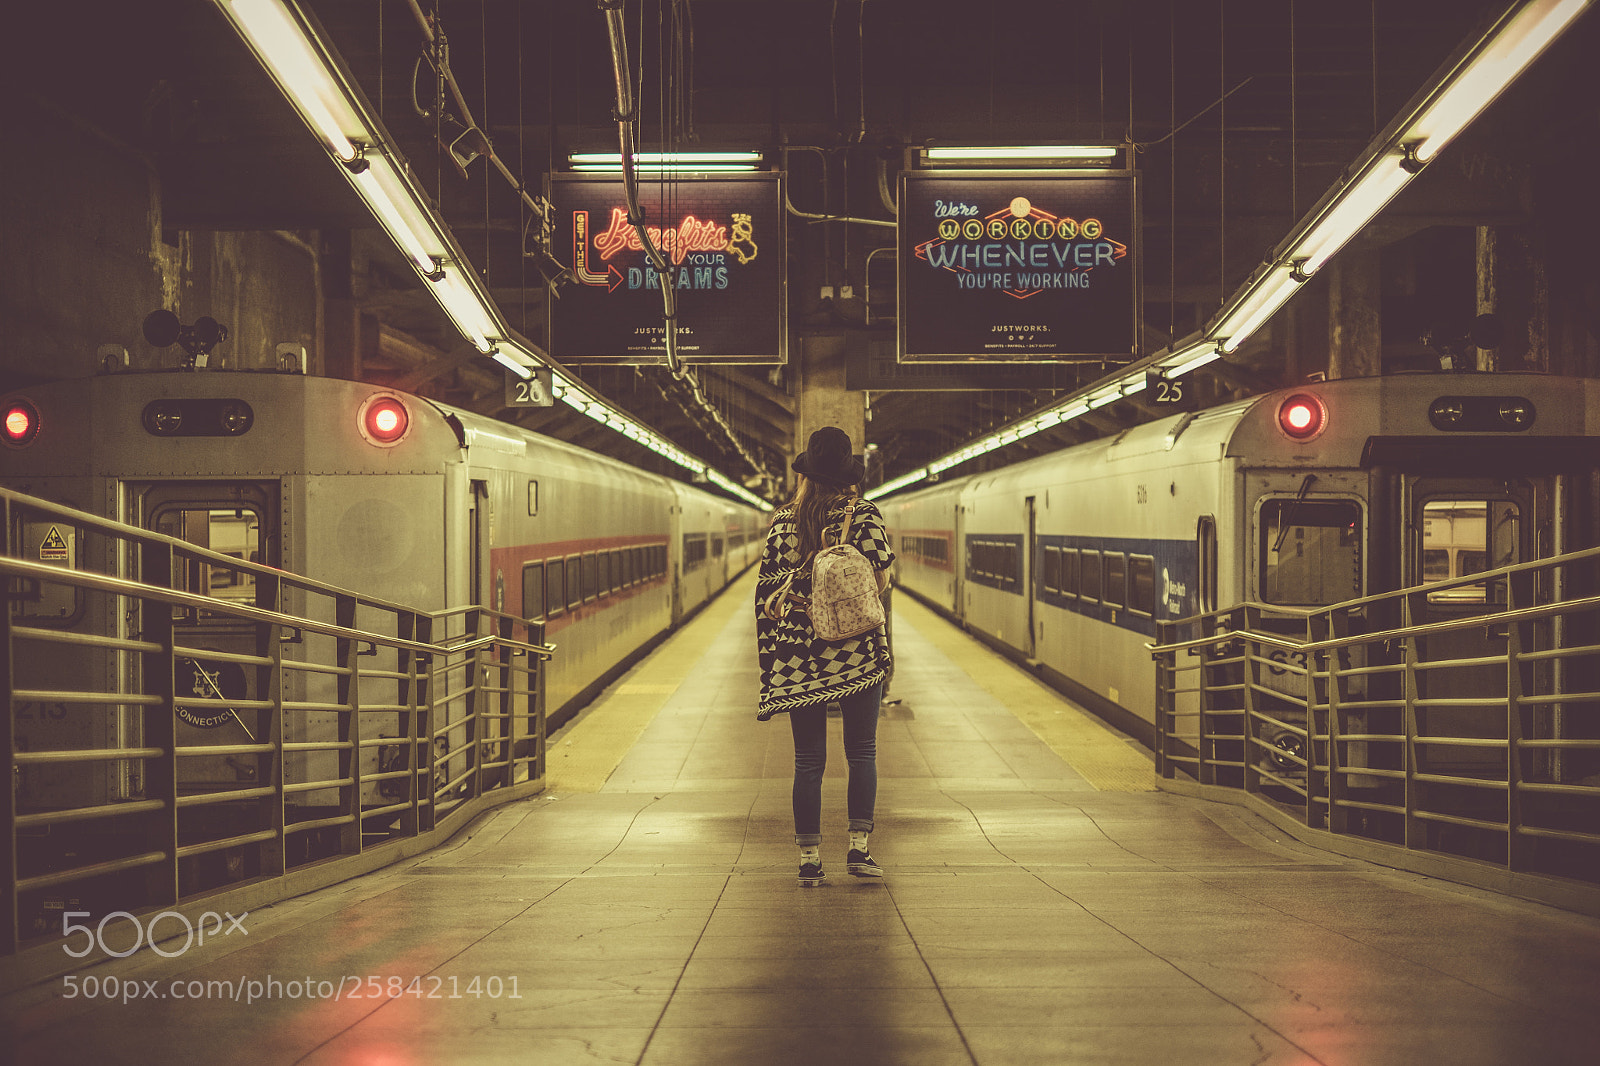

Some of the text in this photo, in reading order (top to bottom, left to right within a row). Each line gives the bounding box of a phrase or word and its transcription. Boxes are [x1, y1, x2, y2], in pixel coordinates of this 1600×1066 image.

[934, 199, 979, 218] We're
[593, 208, 728, 265] Benefits
[939, 220, 1101, 239] WORKING
[576, 214, 585, 267] GET THE
[687, 254, 725, 265] YOUR
[926, 241, 1116, 268] WHENEVER
[957, 273, 1090, 289] YOU'RE WORKING
[991, 325, 1051, 333] JUSTWORKS.
[515, 380, 543, 402] 26
[1156, 381, 1183, 402] 25
[175, 706, 237, 726] CONNECTICU
